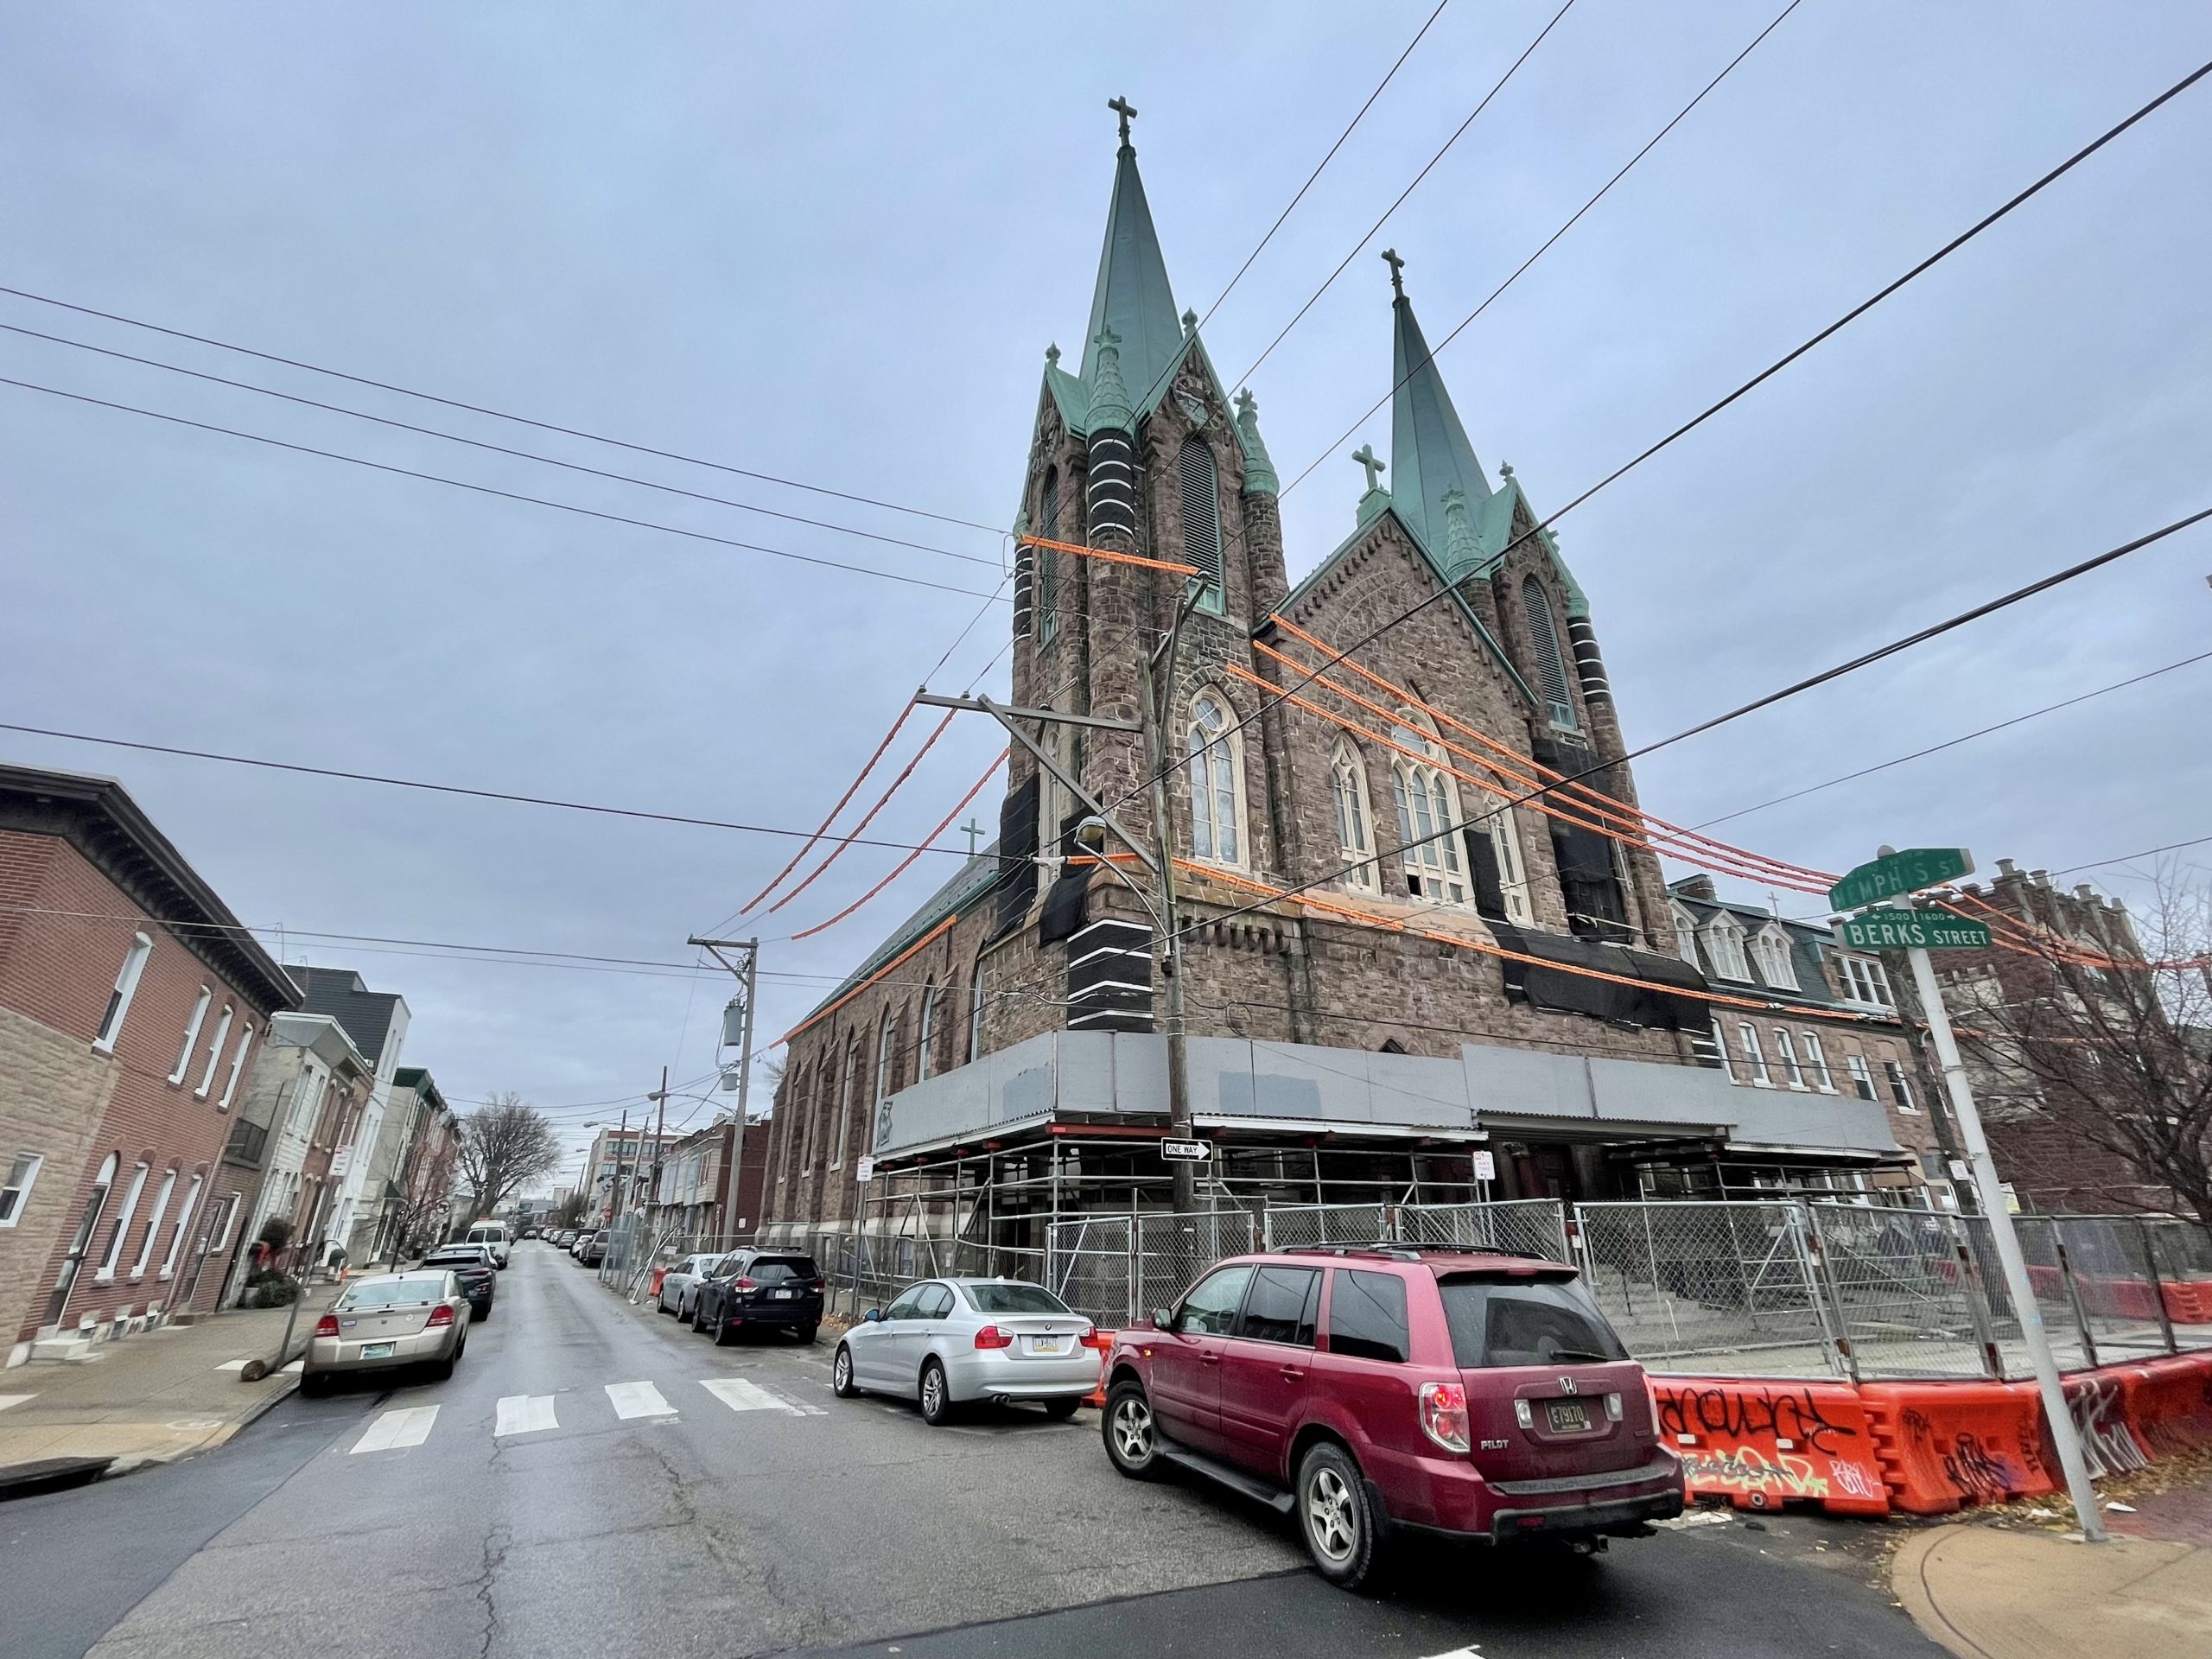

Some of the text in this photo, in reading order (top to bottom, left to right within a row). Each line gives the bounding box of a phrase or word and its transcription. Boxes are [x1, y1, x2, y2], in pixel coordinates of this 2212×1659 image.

[1883, 912, 1945, 921] 1500 1600
[1849, 924, 1987, 945] BERKS STREET
[1167, 1145, 1181, 1154] ONE
[1480, 1439, 1509, 1450] PILOT
